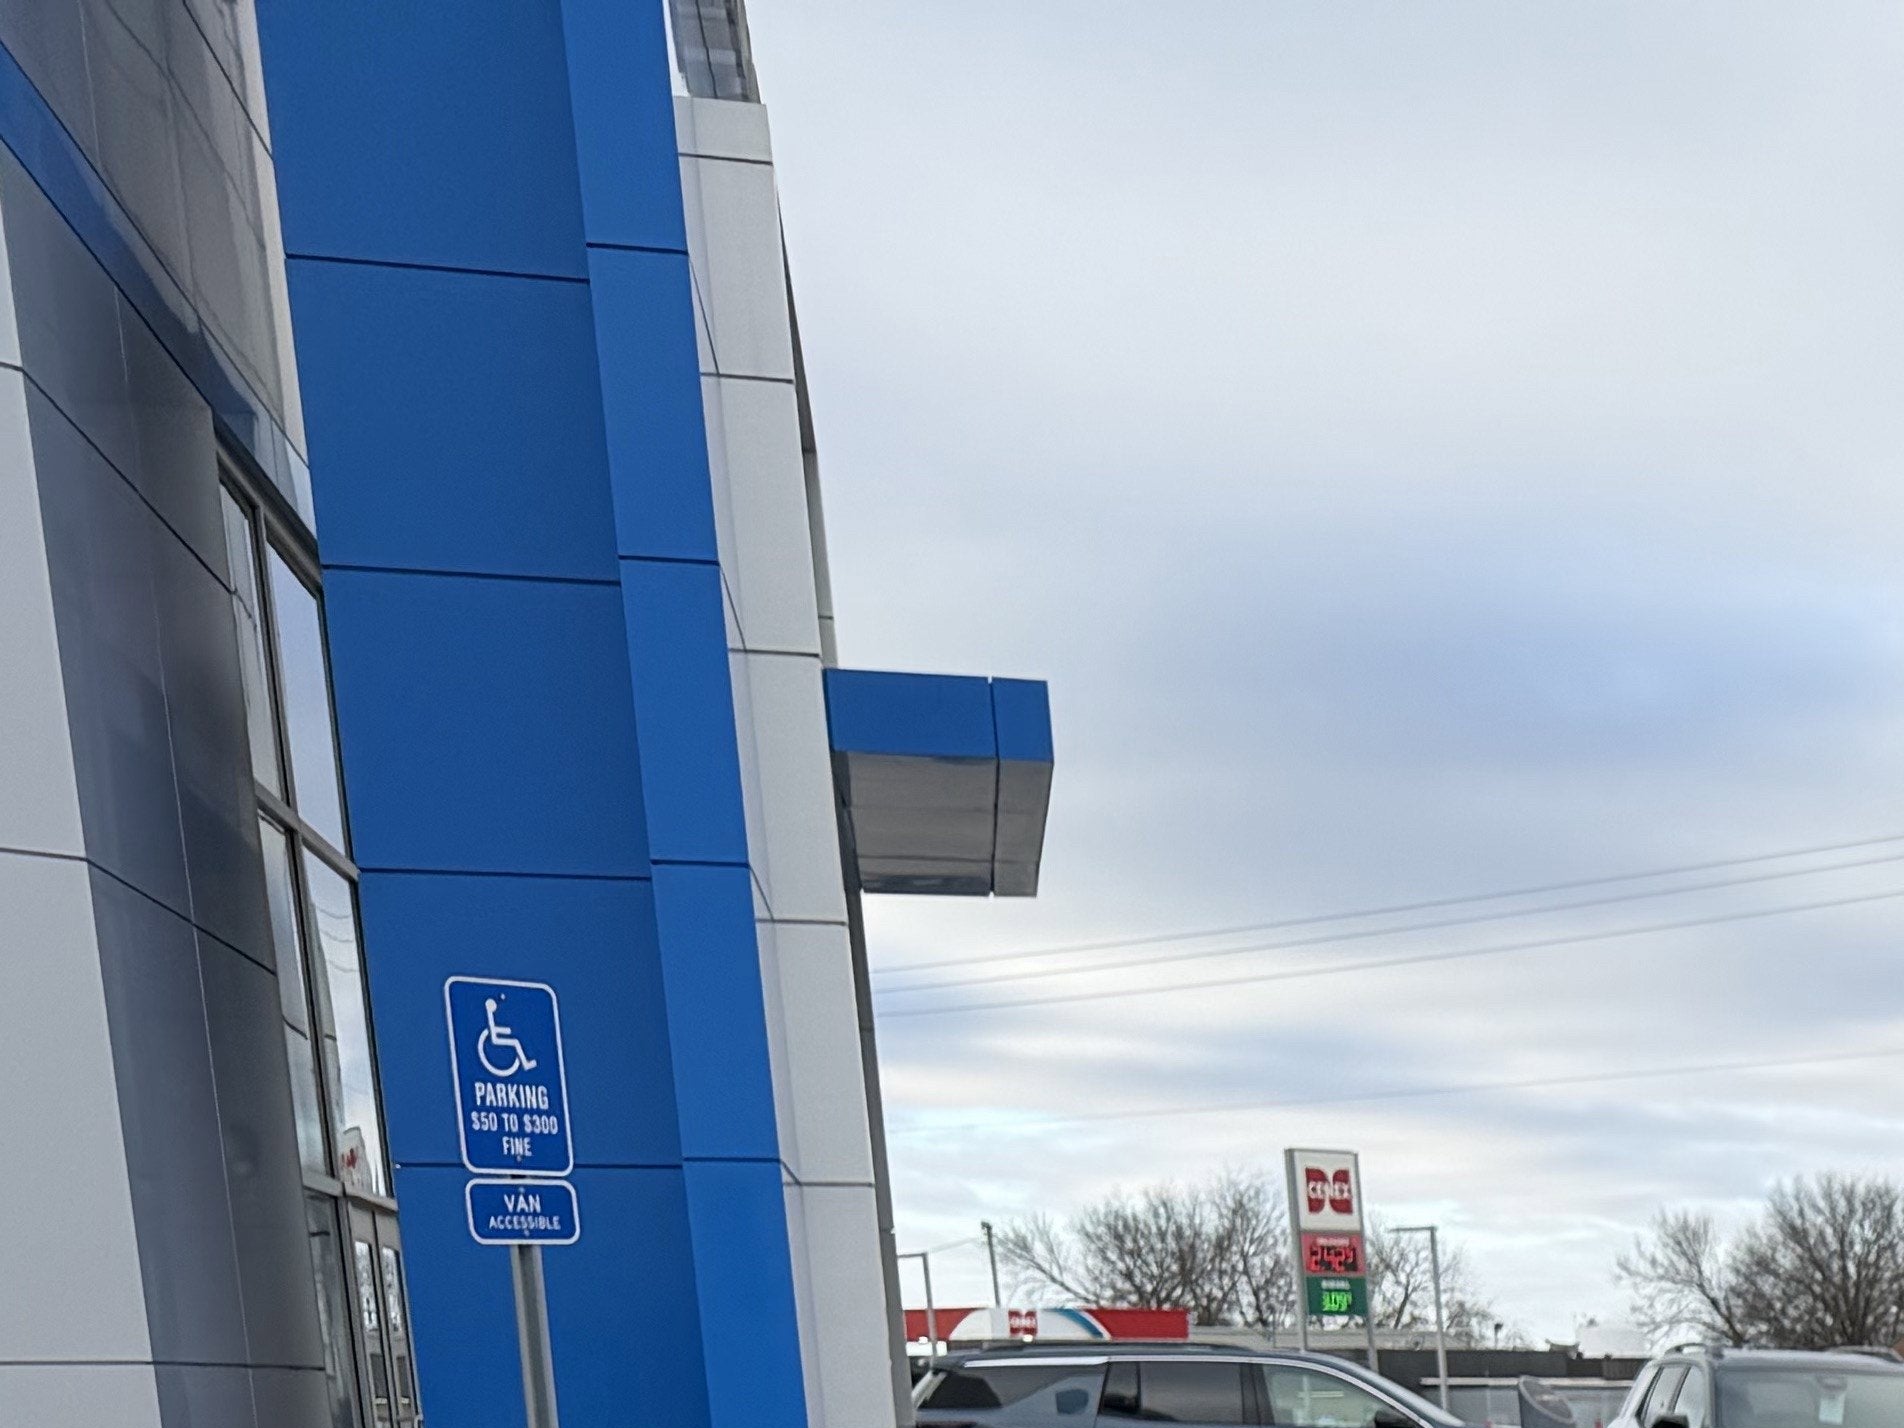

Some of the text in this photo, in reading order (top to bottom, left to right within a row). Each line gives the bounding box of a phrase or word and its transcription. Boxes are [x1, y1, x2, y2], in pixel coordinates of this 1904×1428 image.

[474, 1082, 549, 1110] PARKING
[471, 1111, 558, 1134] $50 TO $300
[502, 1136, 532, 1157] FINE
[504, 1194, 541, 1213] VAN
[489, 1215, 561, 1231] ACCESSIBLE
